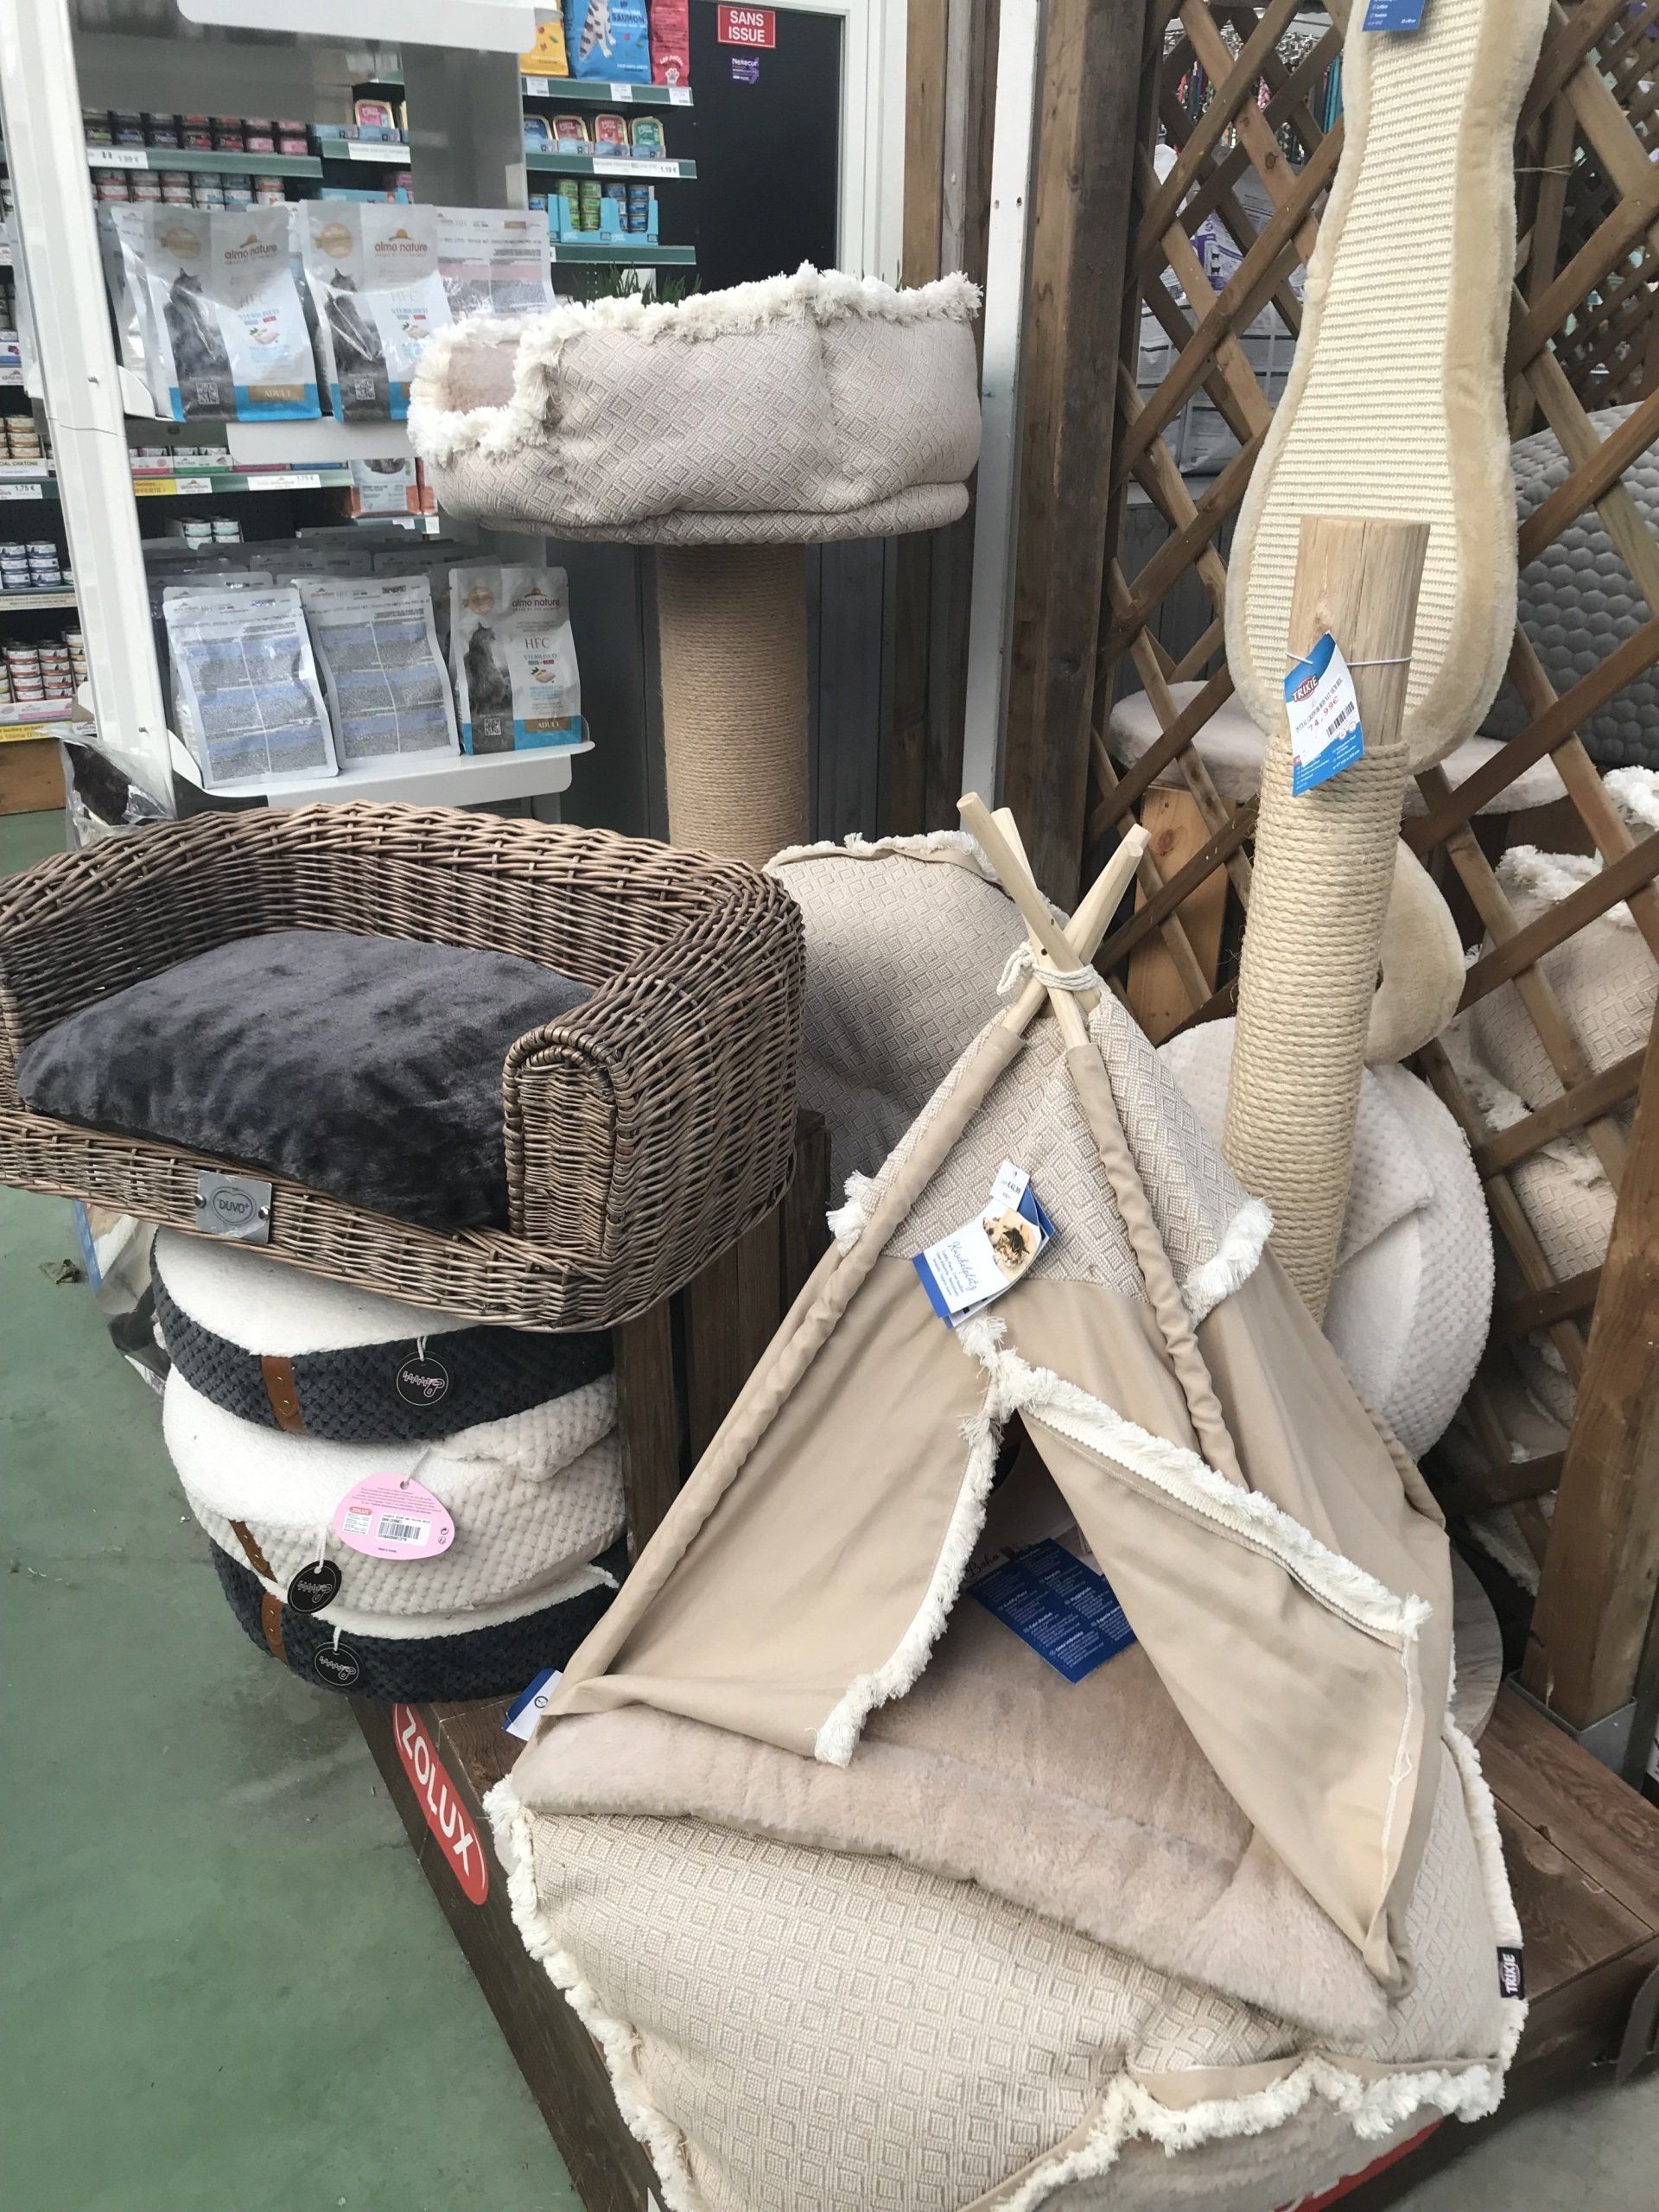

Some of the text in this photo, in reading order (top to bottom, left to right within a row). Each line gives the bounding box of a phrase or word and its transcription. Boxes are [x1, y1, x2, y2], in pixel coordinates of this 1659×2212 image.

[729, 10, 764, 27] SANS
[728, 26, 766, 43] ISSUE
[225, 244, 277, 259] almo nature
[374, 241, 428, 252] almo nature
[512, 598, 560, 607] almo nature
[525, 637, 550, 649] HFC
[1293, 675, 1319, 702] TRIXIE
[403, 1706, 474, 1877] ZOLUX
[1502, 1954, 1518, 1994] TRIXIE
